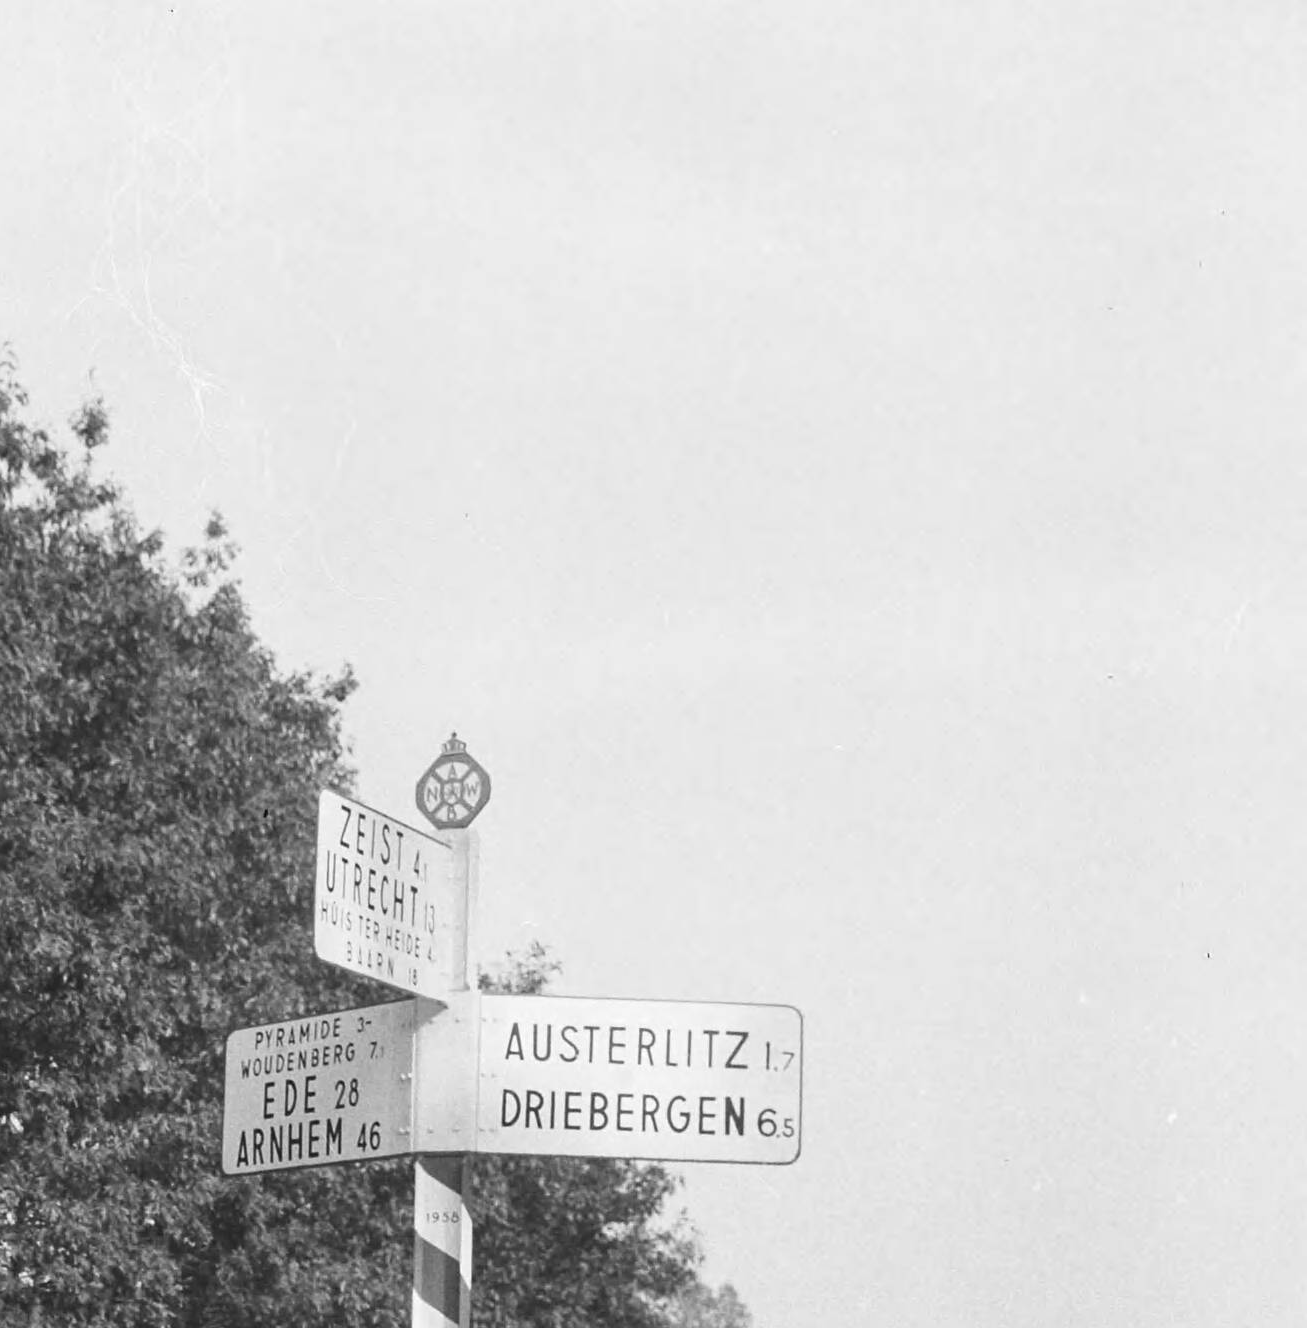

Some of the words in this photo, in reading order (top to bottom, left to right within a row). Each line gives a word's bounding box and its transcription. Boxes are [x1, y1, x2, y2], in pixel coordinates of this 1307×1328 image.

[340, 804, 404, 871] ZEIST
[326, 849, 419, 928] UTRECHT
[424, 901, 436, 936] 13
[346, 940, 394, 978] BAARN
[358, 915, 380, 944] TER
[385, 925, 421, 959] HEIDE
[255, 1017, 341, 1050] PYRAMIDE
[505, 1021, 750, 1070] AUSTERLITZ
[765, 1040, 796, 1073] 1.7
[241, 1041, 356, 1080] WOUDENBERG
[263, 1075, 317, 1120] EDE
[335, 1077, 360, 1110] 28
[501, 1088, 745, 1137] DRIEBERGEN
[757, 1108, 795, 1139] 6.5
[236, 1116, 343, 1168] ARNHEM
[357, 1120, 382, 1152] 46
